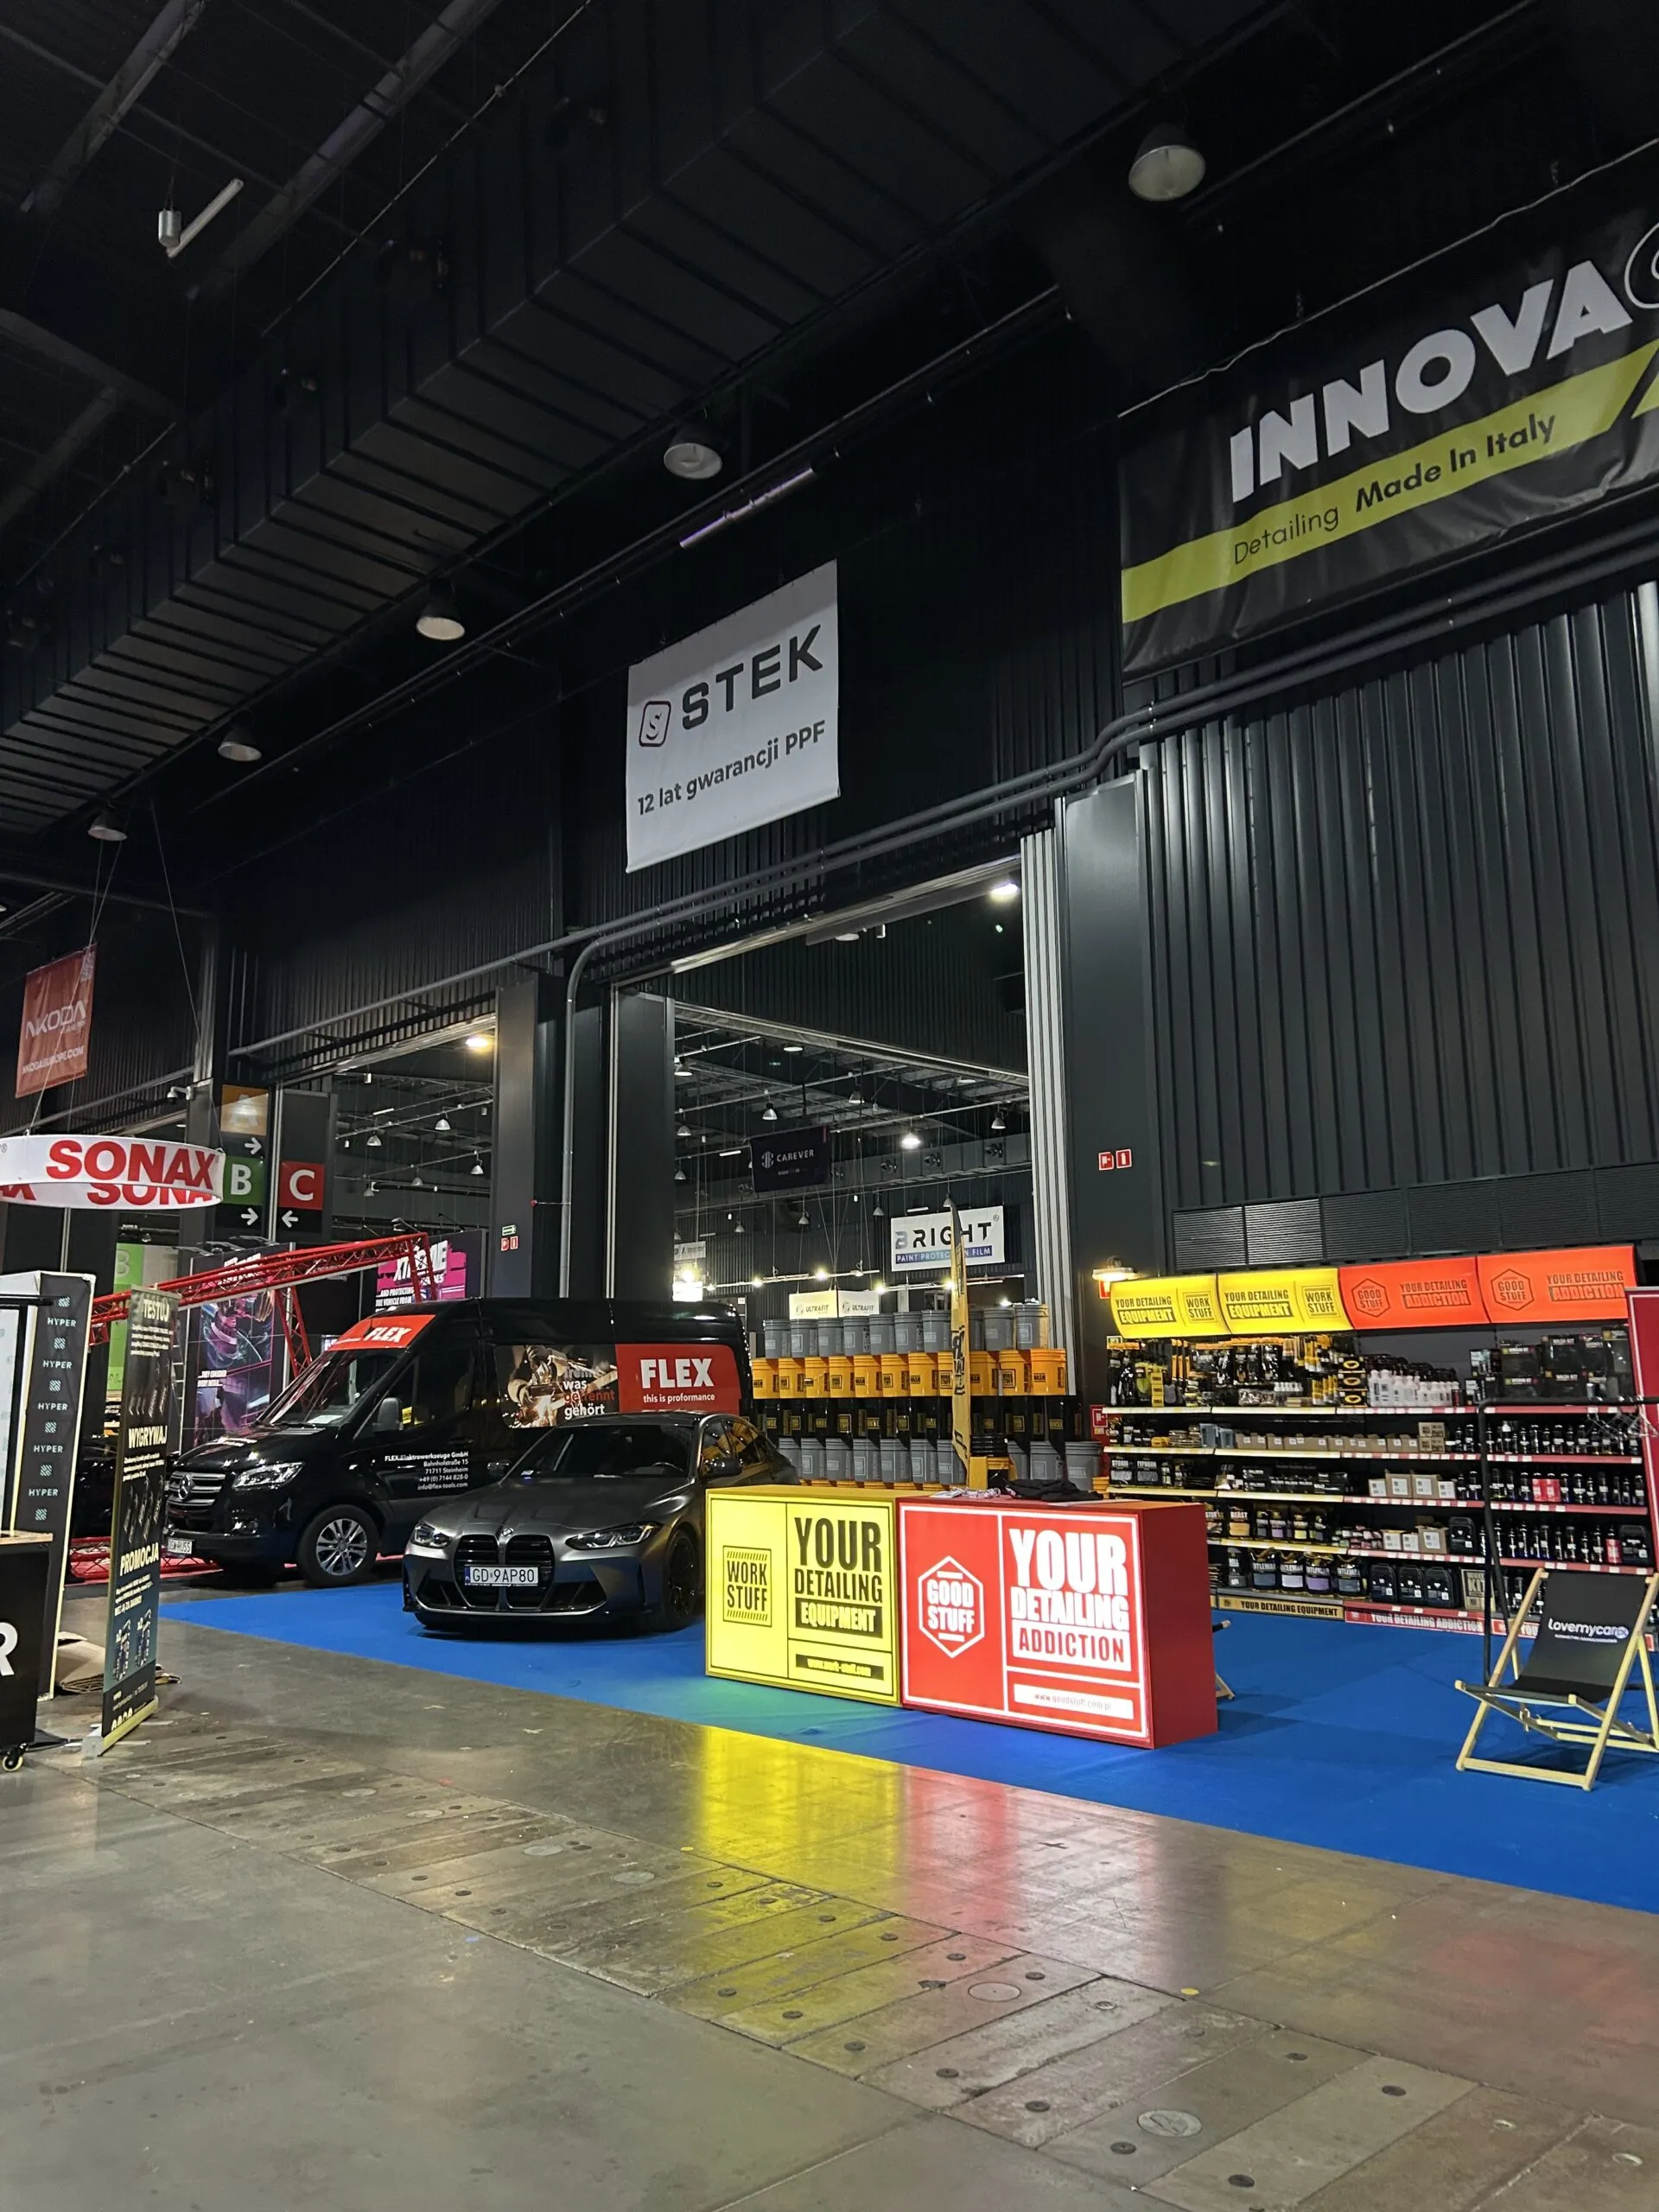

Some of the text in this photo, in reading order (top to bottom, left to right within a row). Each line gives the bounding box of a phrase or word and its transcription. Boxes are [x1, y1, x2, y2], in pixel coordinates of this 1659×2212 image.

[1230, 260, 1633, 504] INNOVA
[1234, 413, 1556, 565] Detailing Made In Italy
[682, 624, 823, 730] STEK
[638, 720, 825, 816] 12 lat gwarancji PPF
[231, 1094, 258, 1128] A
[776, 1148, 815, 1162] CAREVER
[46, 1140, 216, 1190] SONAX
[231, 1164, 251, 1196] B
[289, 1169, 315, 1201] C
[896, 1247, 990, 1262] PAINT PROTECN FILM
[1547, 1271, 1624, 1285] YOUR DETAILING
[1400, 1280, 1467, 1294] YOUR DETAILING
[1497, 1281, 1524, 1292] GOOD
[1552, 1284, 1624, 1300] ADDICTION
[1115, 1295, 1173, 1309] YOUR DETAILING
[1186, 1297, 1211, 1308] WORK
[1224, 1289, 1289, 1302] YOUR DETAILING
[1305, 1291, 1331, 1302] WORK
[1357, 1290, 1382, 1300] GOOD
[1405, 1294, 1471, 1308] ADDICTION
[1500, 1290, 1527, 1301] STUFF
[143, 1299, 170, 1322] TESTUJ
[1230, 1302, 1292, 1318] EQUIPMENT
[1307, 1302, 1335, 1313] STUFF
[1360, 1299, 1383, 1308] STUFF
[1121, 1308, 1174, 1324] EQUIPMENT
[1188, 1307, 1213, 1319] STUFF
[47, 1317, 77, 1327] HYPER
[363, 1327, 412, 1343] FLEX
[42, 1360, 73, 1370] HYPER
[640, 1358, 715, 1389] FLEX
[563, 1380, 588, 1390] was
[38, 1402, 68, 1411] HYPER
[643, 1393, 715, 1404] this is proformance
[564, 1403, 605, 1420] gehört
[128, 1425, 168, 1449] WYGRYWAJ
[33, 1445, 63, 1453] HYPER
[29, 1488, 59, 1497] HYPER
[417, 1482, 468, 1491] info@flex-tools.com
[794, 1517, 882, 1573] YOUR
[119, 1541, 159, 1577] PROMOCJA
[1008, 1528, 1128, 1596] YOUR
[473, 1568, 535, 1582] GD 9AP80
[727, 1560, 767, 1586] WORK
[794, 1568, 882, 1604] DETAILING
[926, 1579, 975, 1608] GOOD
[727, 1584, 767, 1611] STUFF
[801, 1601, 876, 1632] EQUIPMENT
[1010, 1586, 1130, 1631] DETAILING
[1241, 1600, 1338, 1617] YOUR DETAILING EQUIPMENT
[927, 1606, 975, 1634] STUFF
[1370, 1613, 1484, 1632] YOUR DETAILING ADDICTION
[1019, 1627, 1124, 1663] ADDICTION
